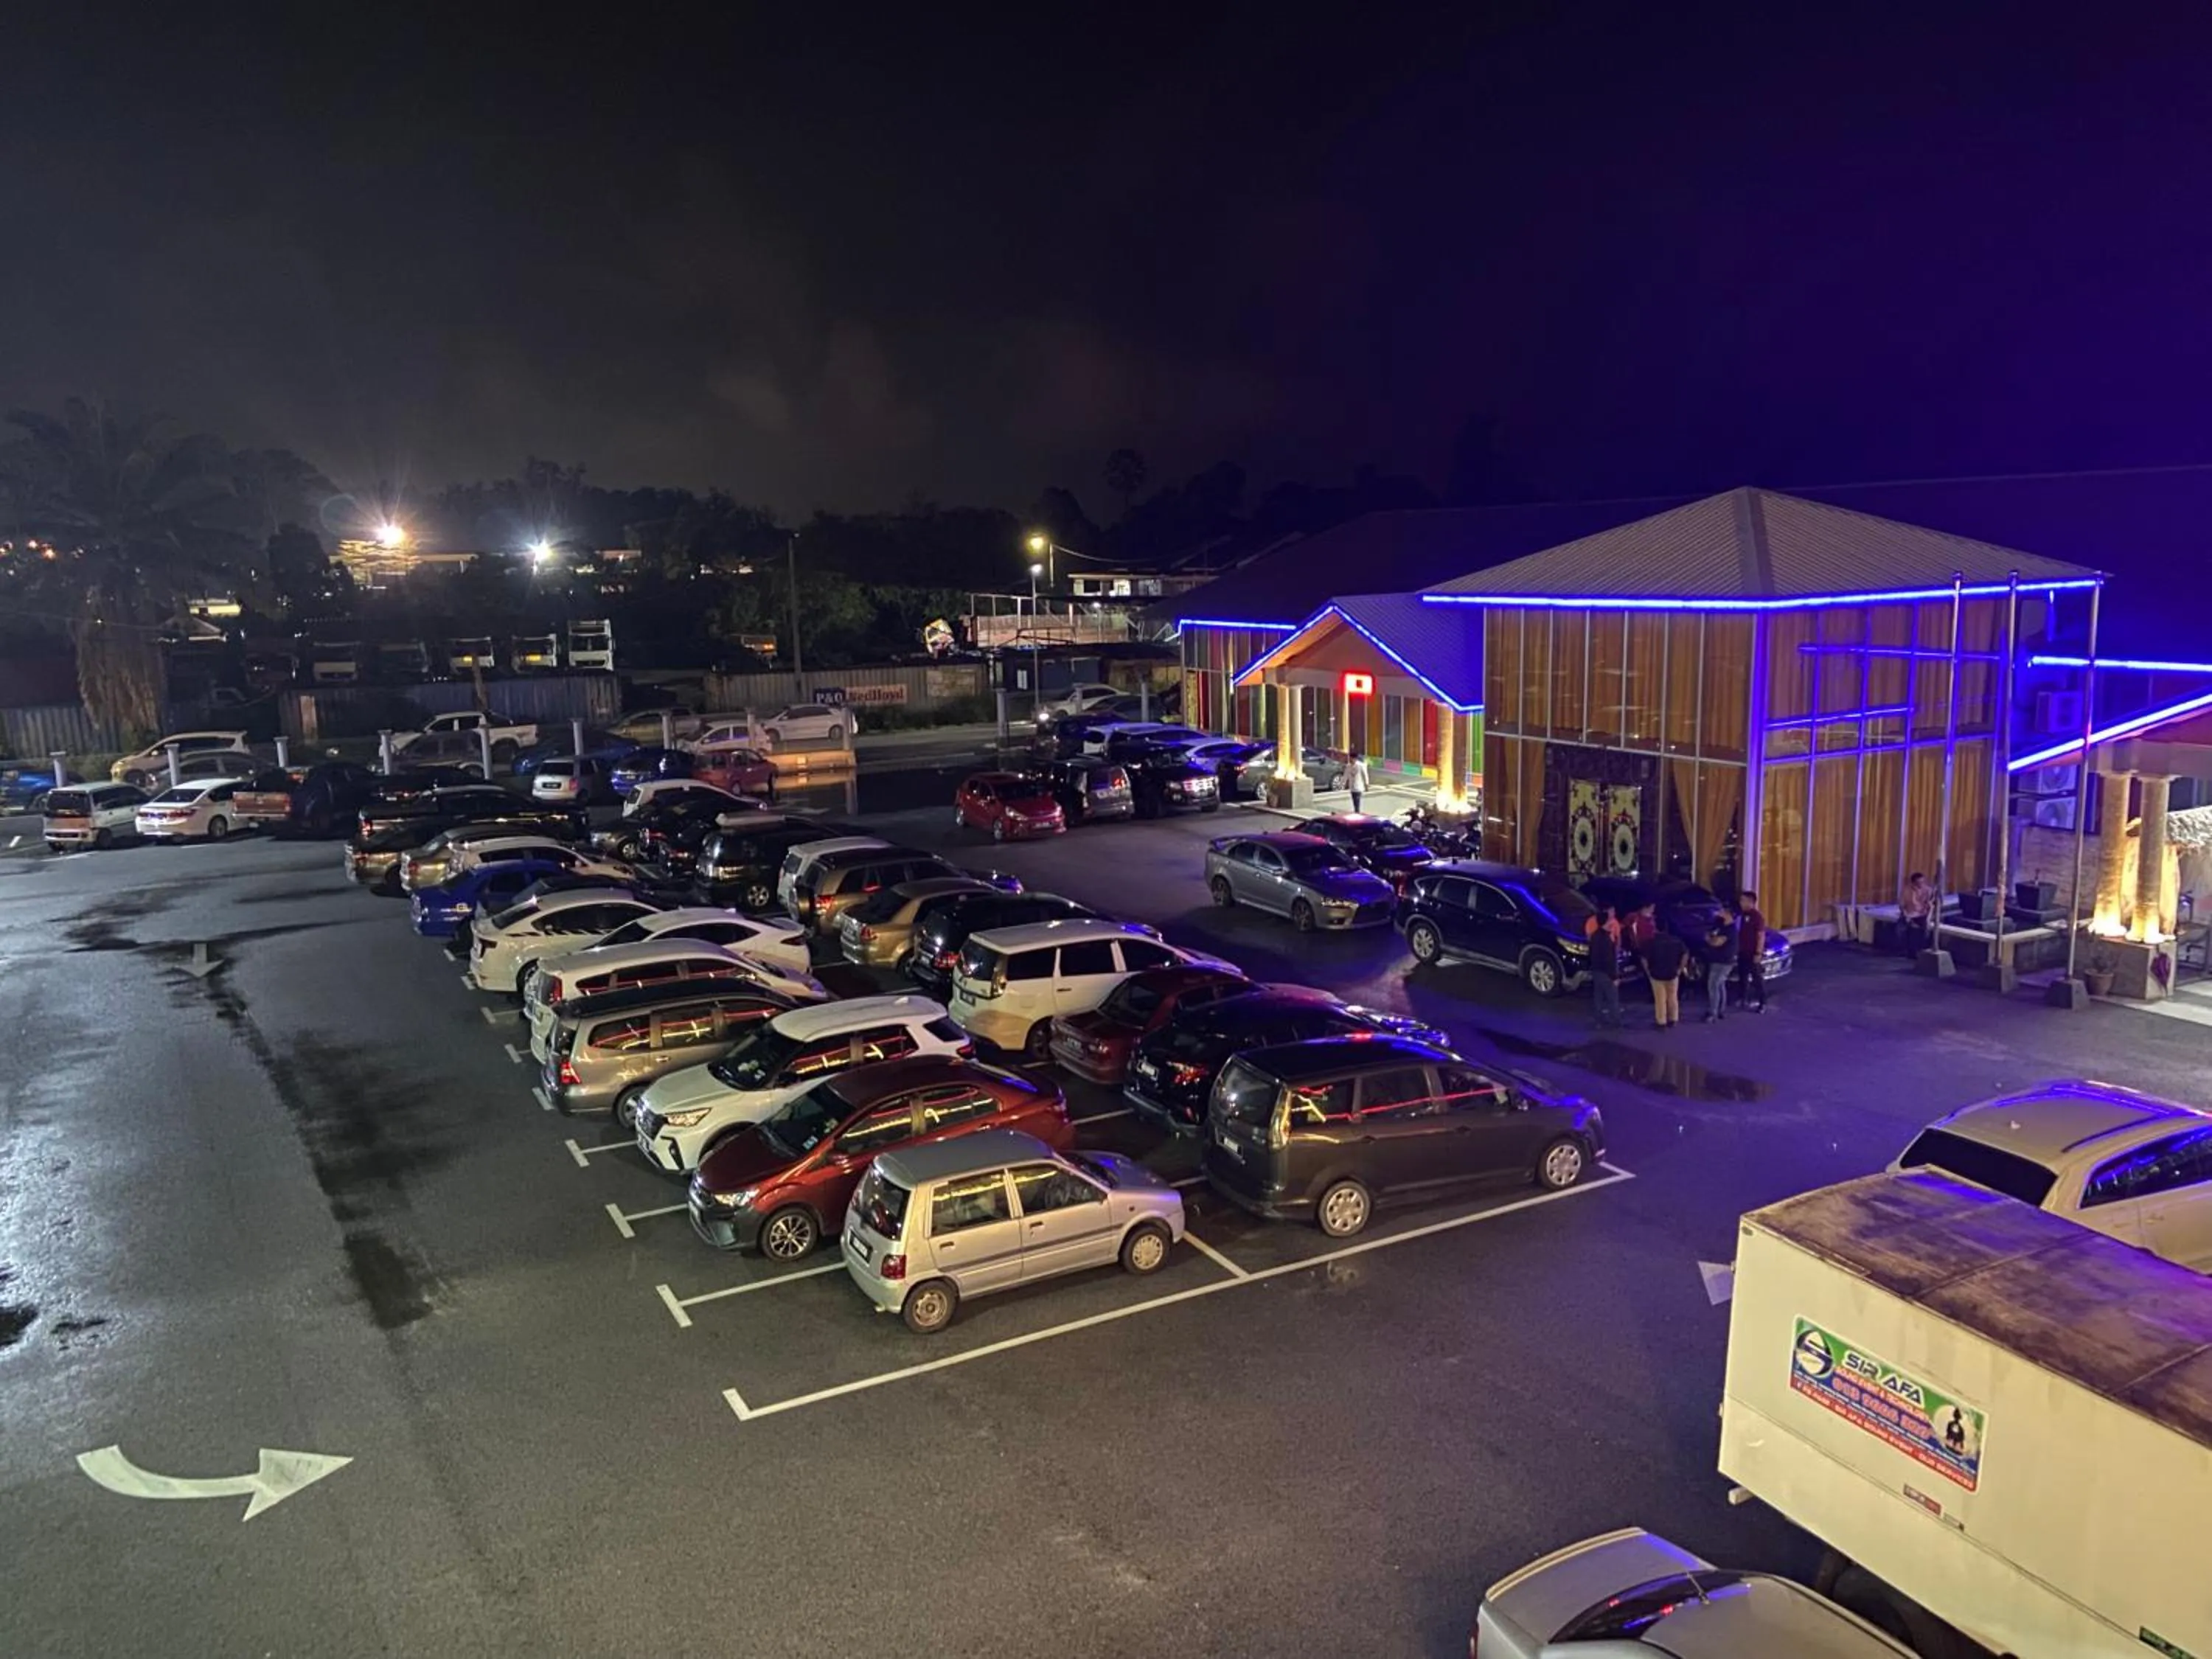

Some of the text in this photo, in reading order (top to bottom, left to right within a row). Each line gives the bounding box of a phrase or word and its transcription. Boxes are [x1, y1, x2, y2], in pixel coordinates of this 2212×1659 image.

[815, 692, 843, 703] P&O
[1846, 1353, 1921, 1404] SIR AFA
